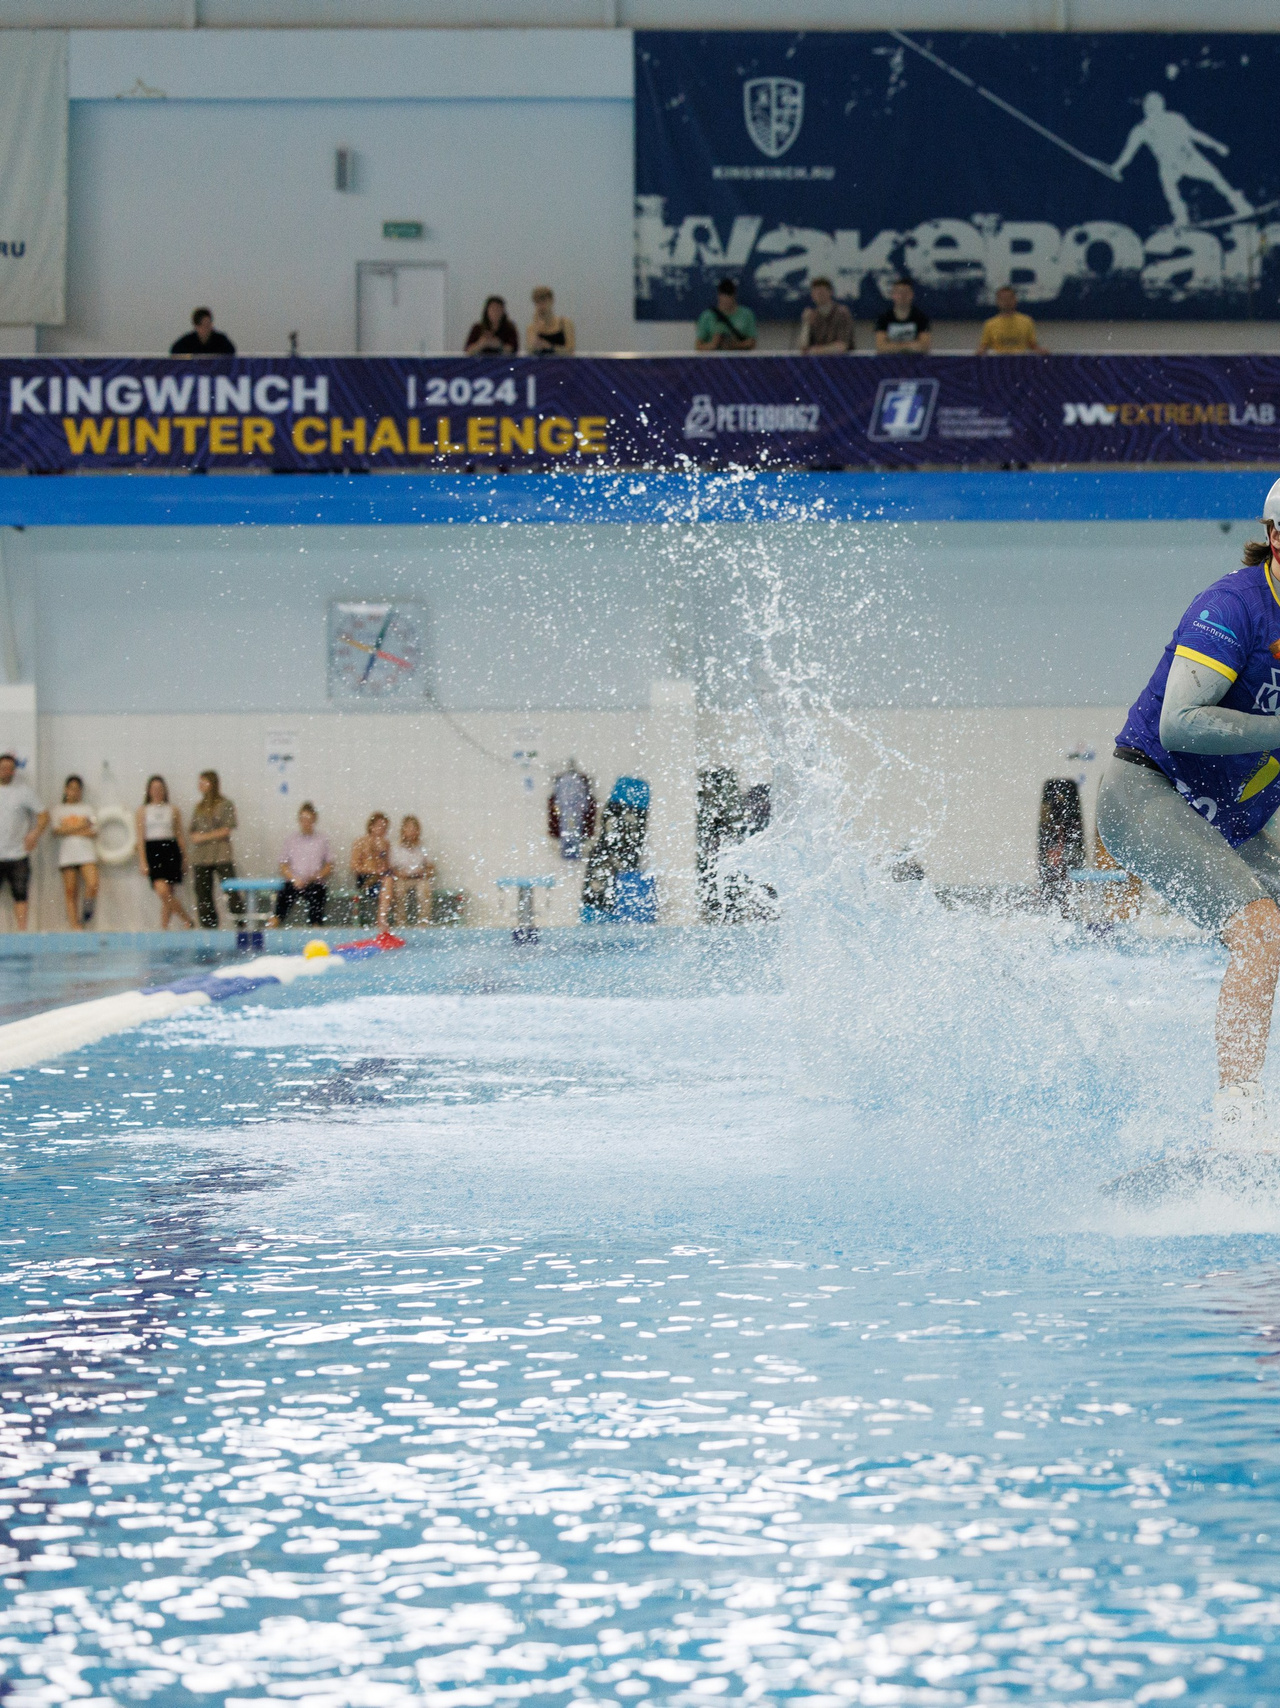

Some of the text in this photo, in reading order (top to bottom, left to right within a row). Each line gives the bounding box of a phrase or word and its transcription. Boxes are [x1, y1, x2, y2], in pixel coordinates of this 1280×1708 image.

[10, 376, 517, 414] KINGWINCH 2024
[63, 416, 608, 455] WINTER CHALLENGE
